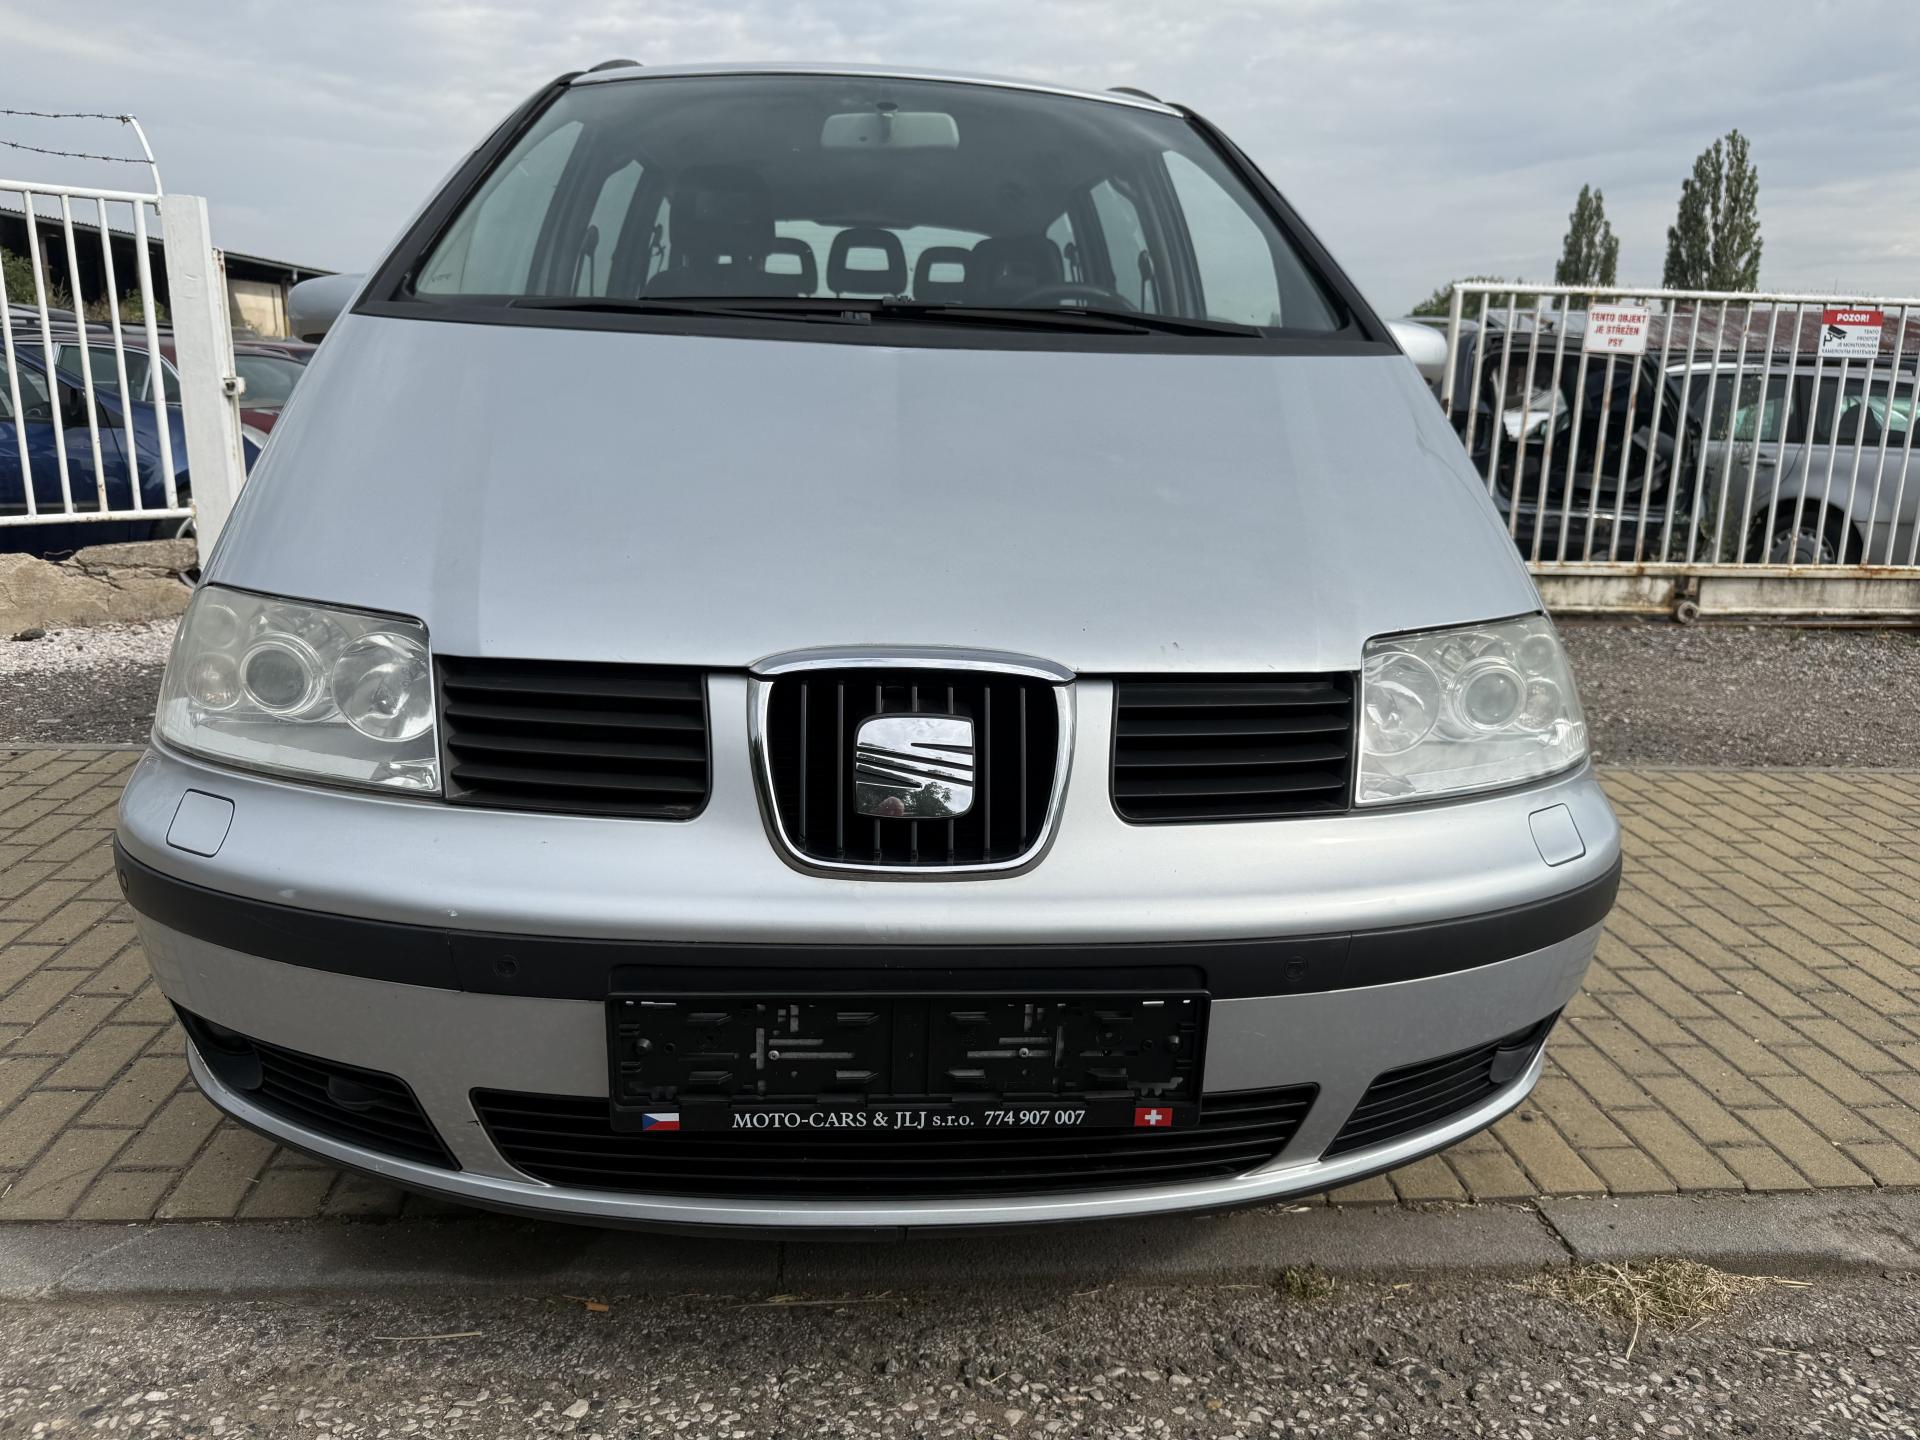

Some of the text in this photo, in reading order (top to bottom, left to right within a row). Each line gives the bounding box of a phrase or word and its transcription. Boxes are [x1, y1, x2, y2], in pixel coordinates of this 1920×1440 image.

[1591, 312, 1646, 324] TENTO OBJEKT
[1836, 313, 1870, 323] POZOR!
[1594, 325, 1605, 334] JE
[1607, 337, 1623, 347] PSY
[731, 1109, 1086, 1129] MOTO-CARS & JLJ s.r.o. 774 907 007
